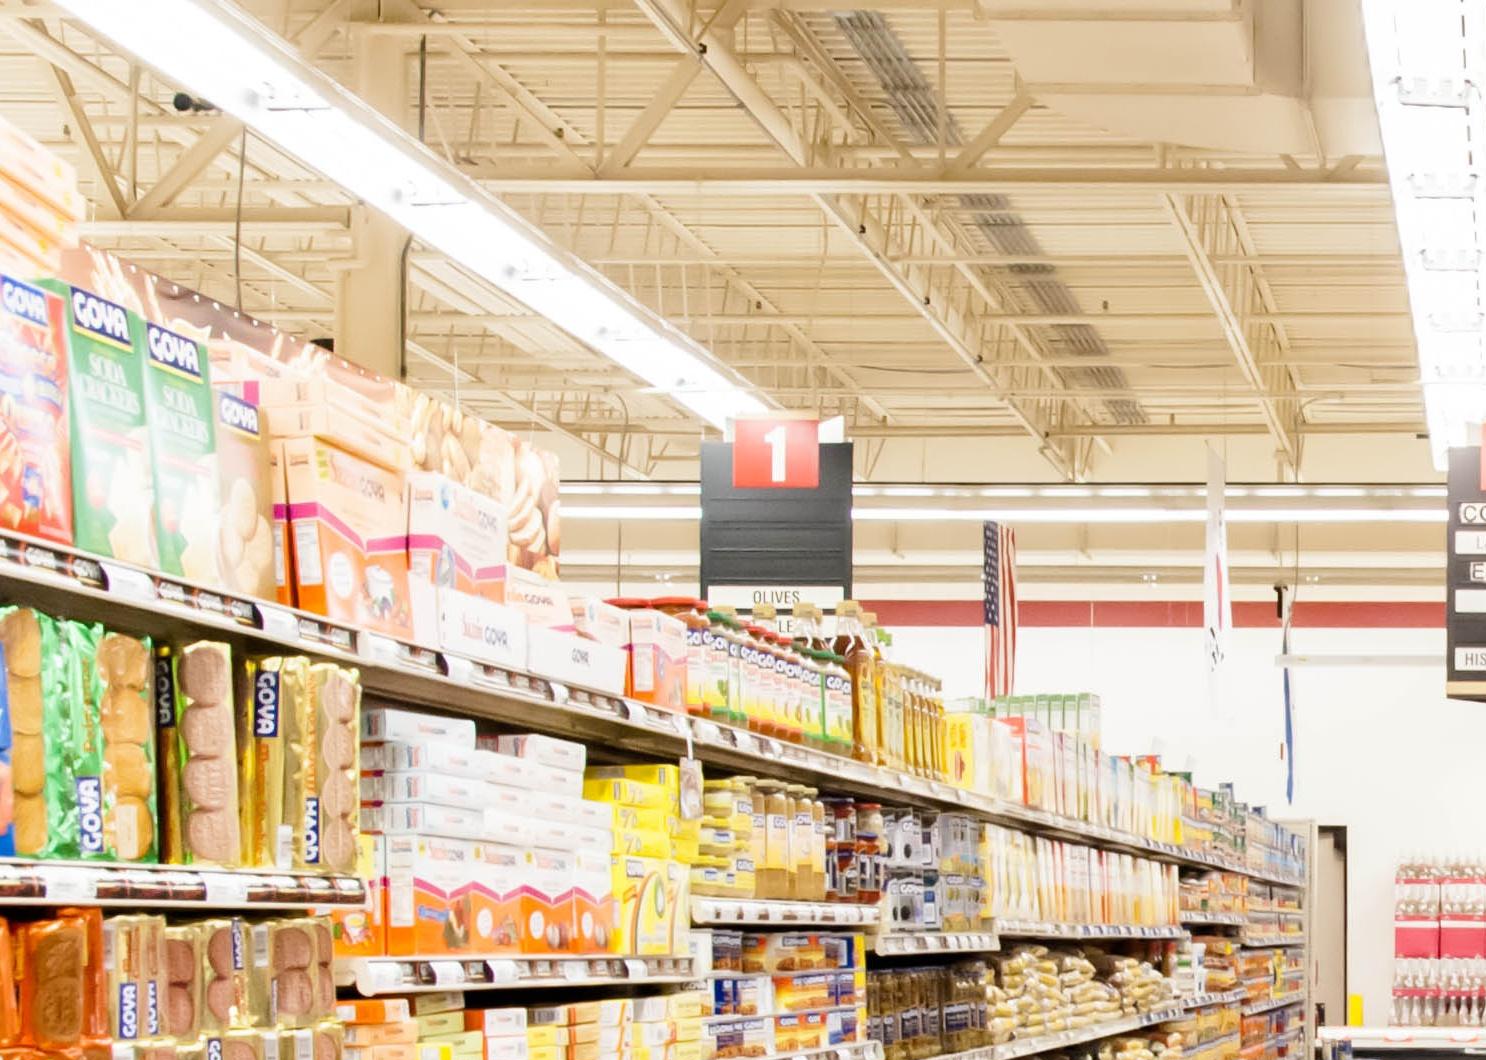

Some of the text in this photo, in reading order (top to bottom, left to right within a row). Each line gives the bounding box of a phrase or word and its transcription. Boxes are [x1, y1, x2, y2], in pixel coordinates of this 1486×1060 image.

[3, 283, 46, 326] GOYA
[73, 291, 130, 345] GOYA
[149, 326, 200, 378] GOYA
[221, 397, 258, 434] GOYA
[764, 426, 786, 482] 1
[753, 590, 800, 605] OLIVES
[158, 660, 172, 724] GOYA
[257, 673, 277, 735] GOYA
[79, 778, 103, 851] GOYA
[121, 985, 137, 1038] GOYA
